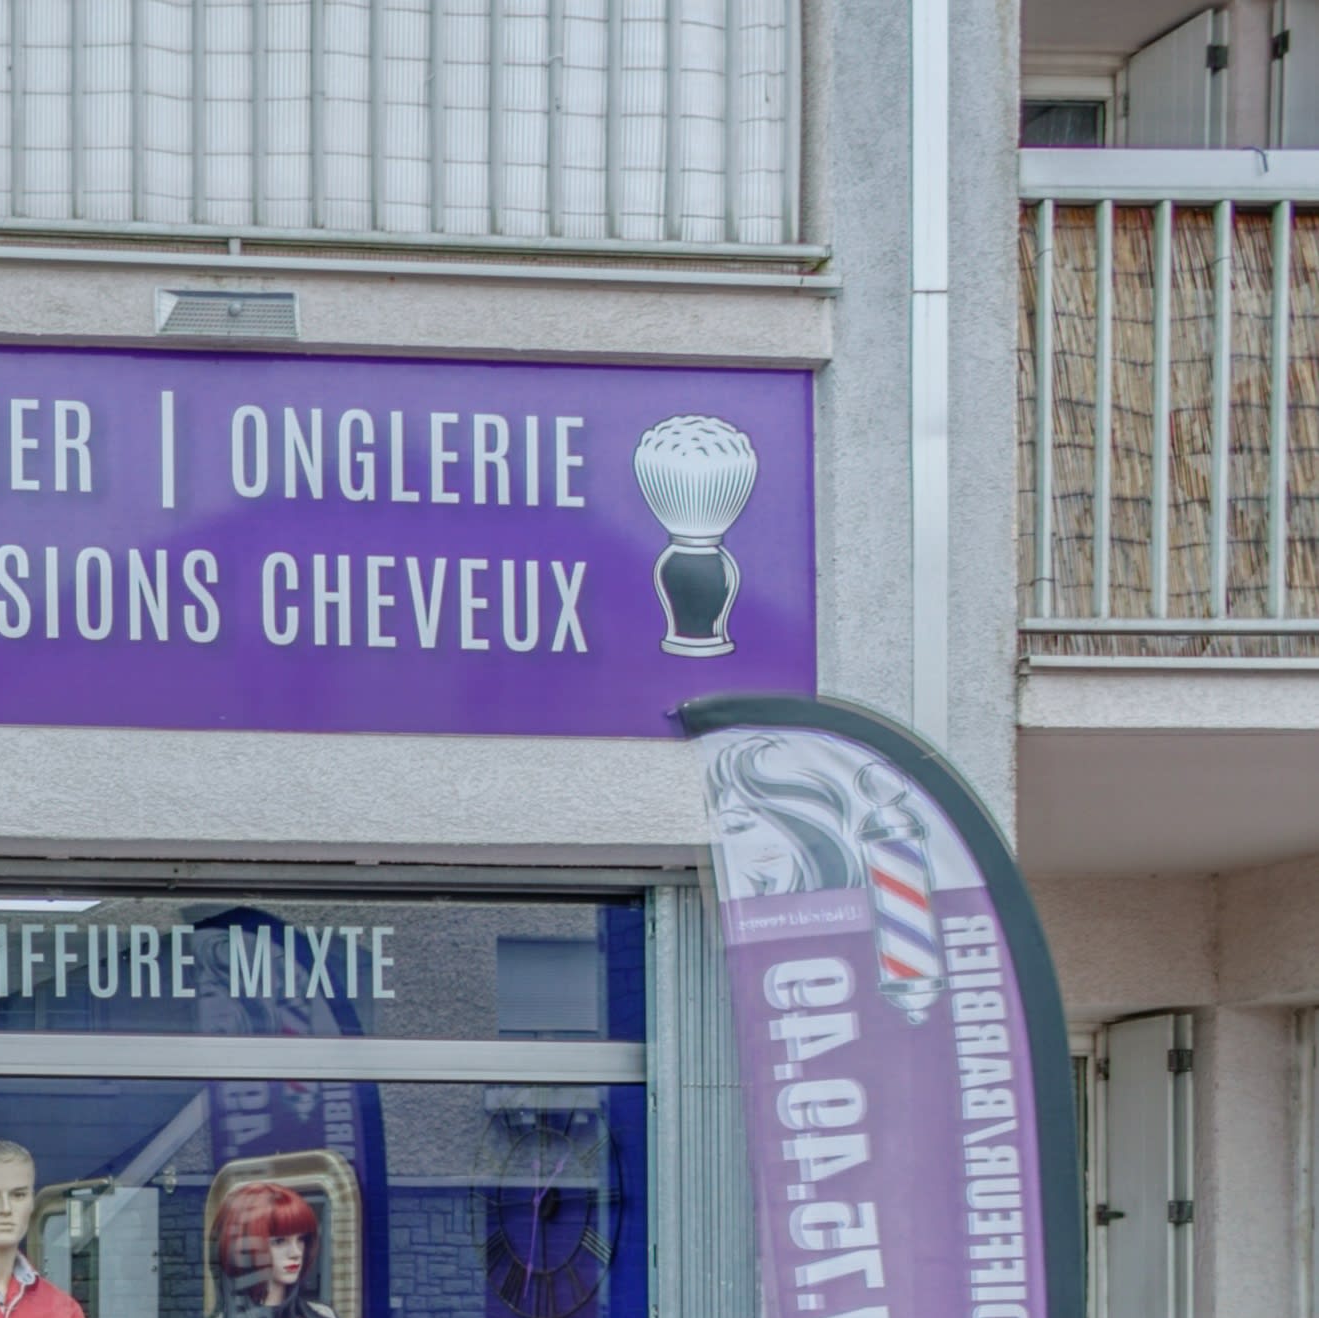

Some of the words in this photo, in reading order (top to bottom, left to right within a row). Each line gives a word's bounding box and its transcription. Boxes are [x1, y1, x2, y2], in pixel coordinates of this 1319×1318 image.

[231, 404, 586, 509] ONGLERIE
[262, 551, 589, 654] CHEVEUX
[229, 923, 396, 999] MIXTE
